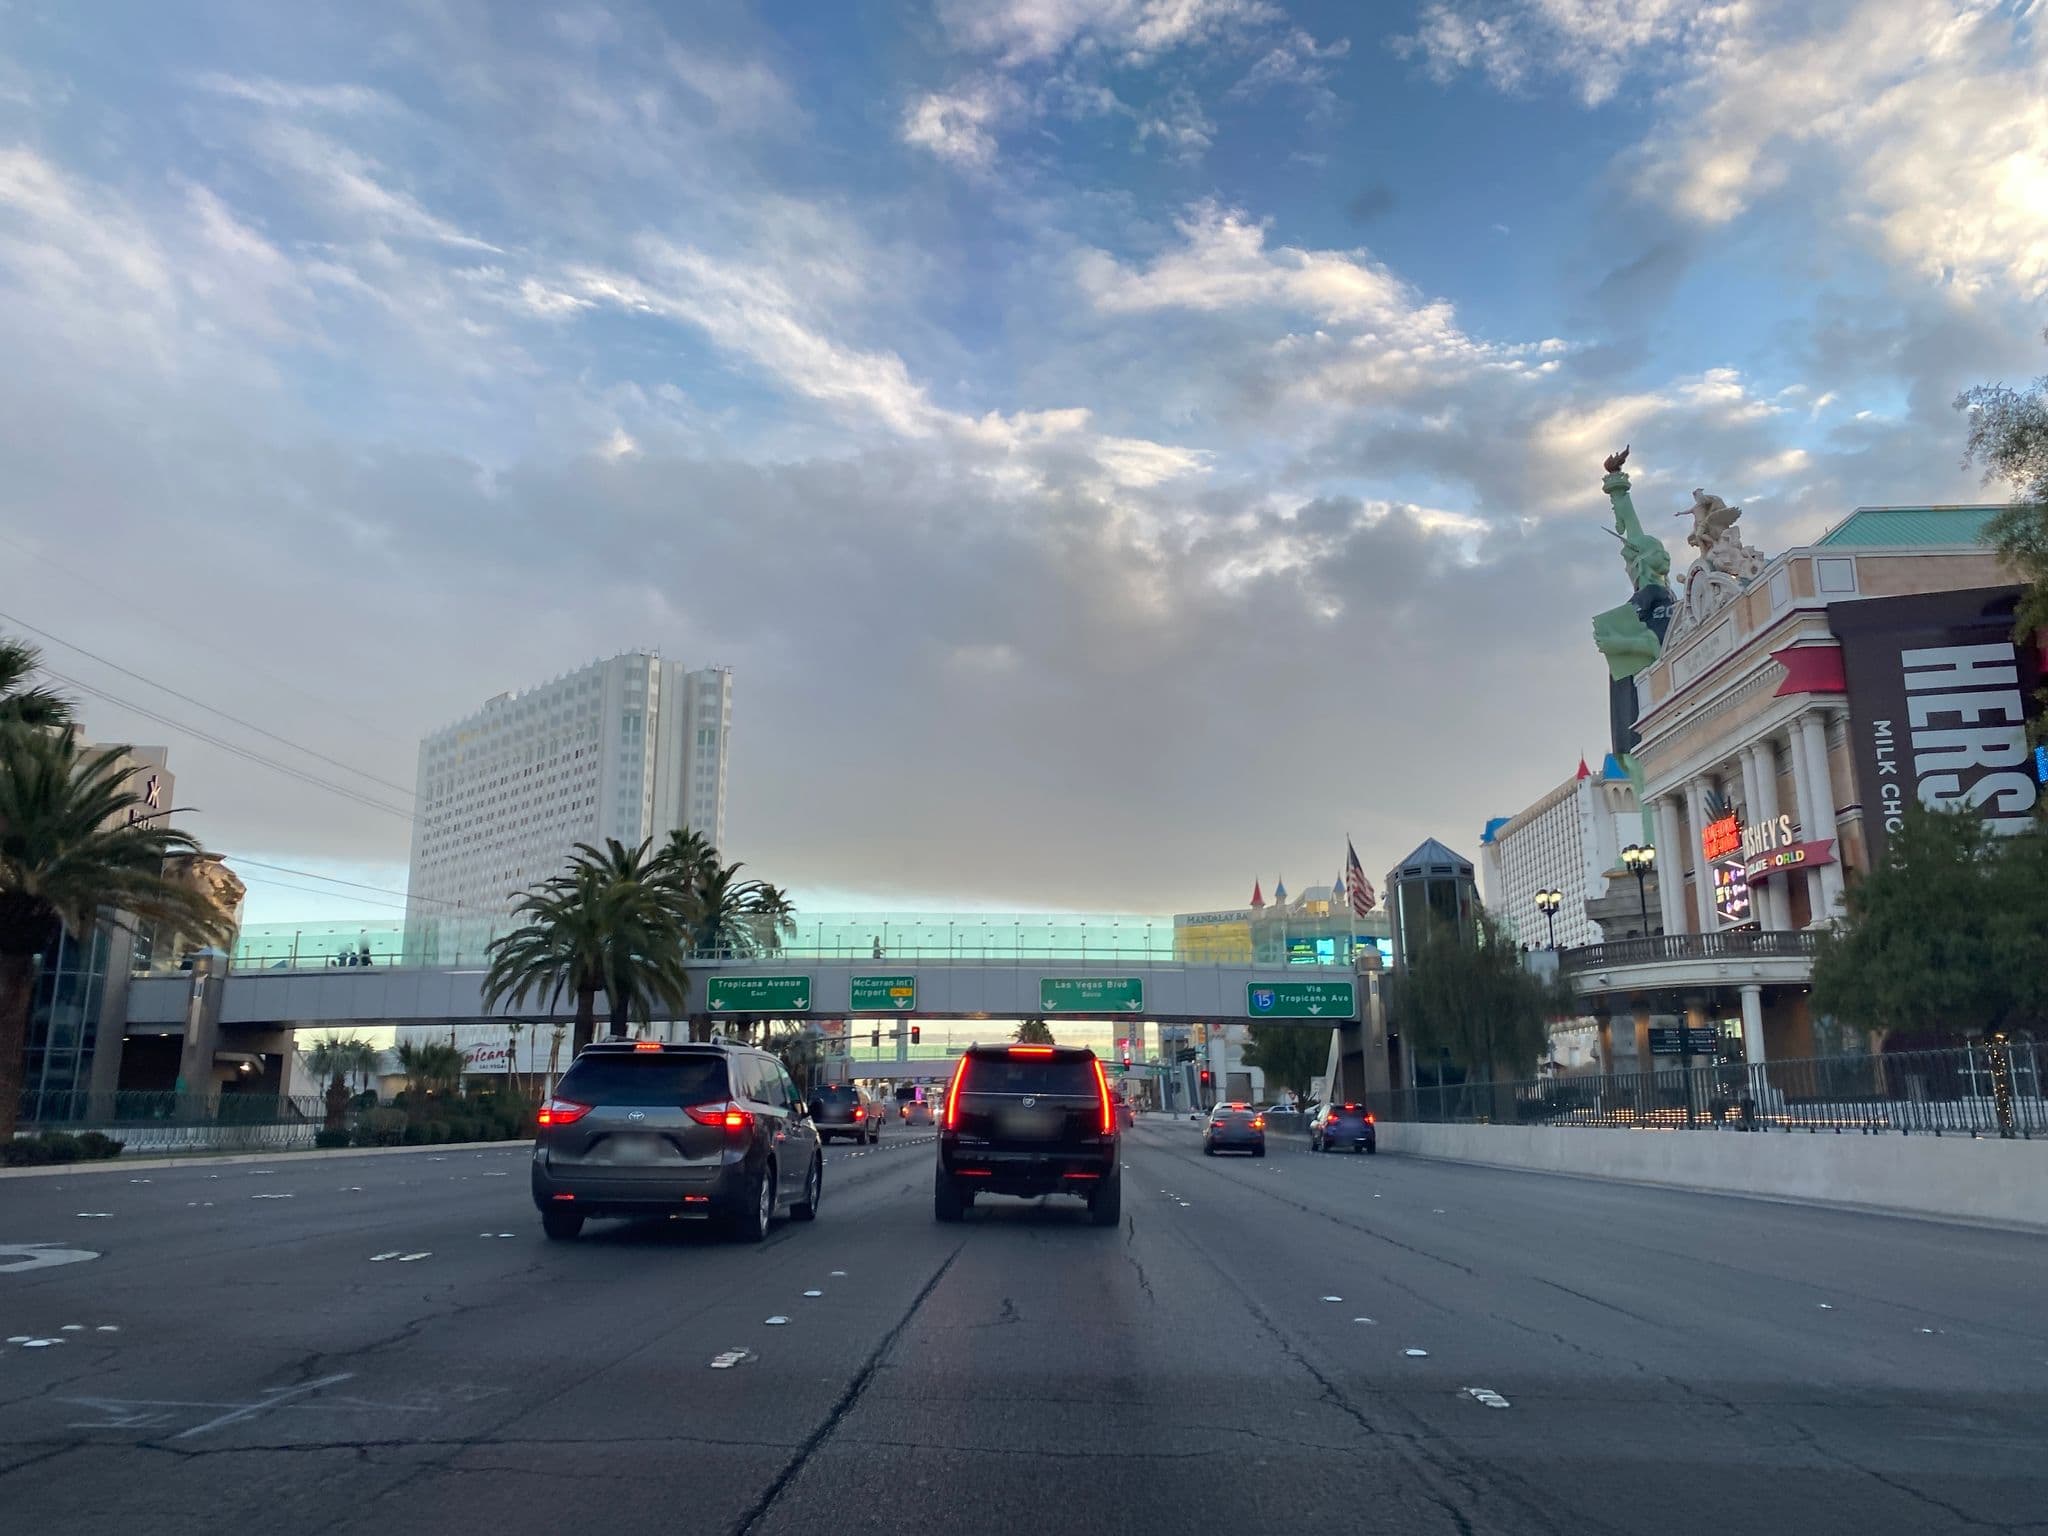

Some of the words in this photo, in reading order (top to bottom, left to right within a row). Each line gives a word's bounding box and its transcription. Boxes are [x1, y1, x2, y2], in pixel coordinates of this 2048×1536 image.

[1873, 720, 1897, 775] MILK
[1881, 783, 1904, 836] CHO
[1768, 850, 1805, 866] WORLD
[1187, 914, 1235, 923] MANDALAY
[1236, 912, 1248, 920] BA
[718, 980, 763, 989] Tropicana
[853, 979, 895, 987] McCarran
[1076, 981, 1103, 990] Vegas
[1107, 980, 1128, 988] Blvd
[853, 988, 886, 997] Airport
[1257, 994, 1271, 1007] 15
[1280, 995, 1327, 1003] Tropicana
